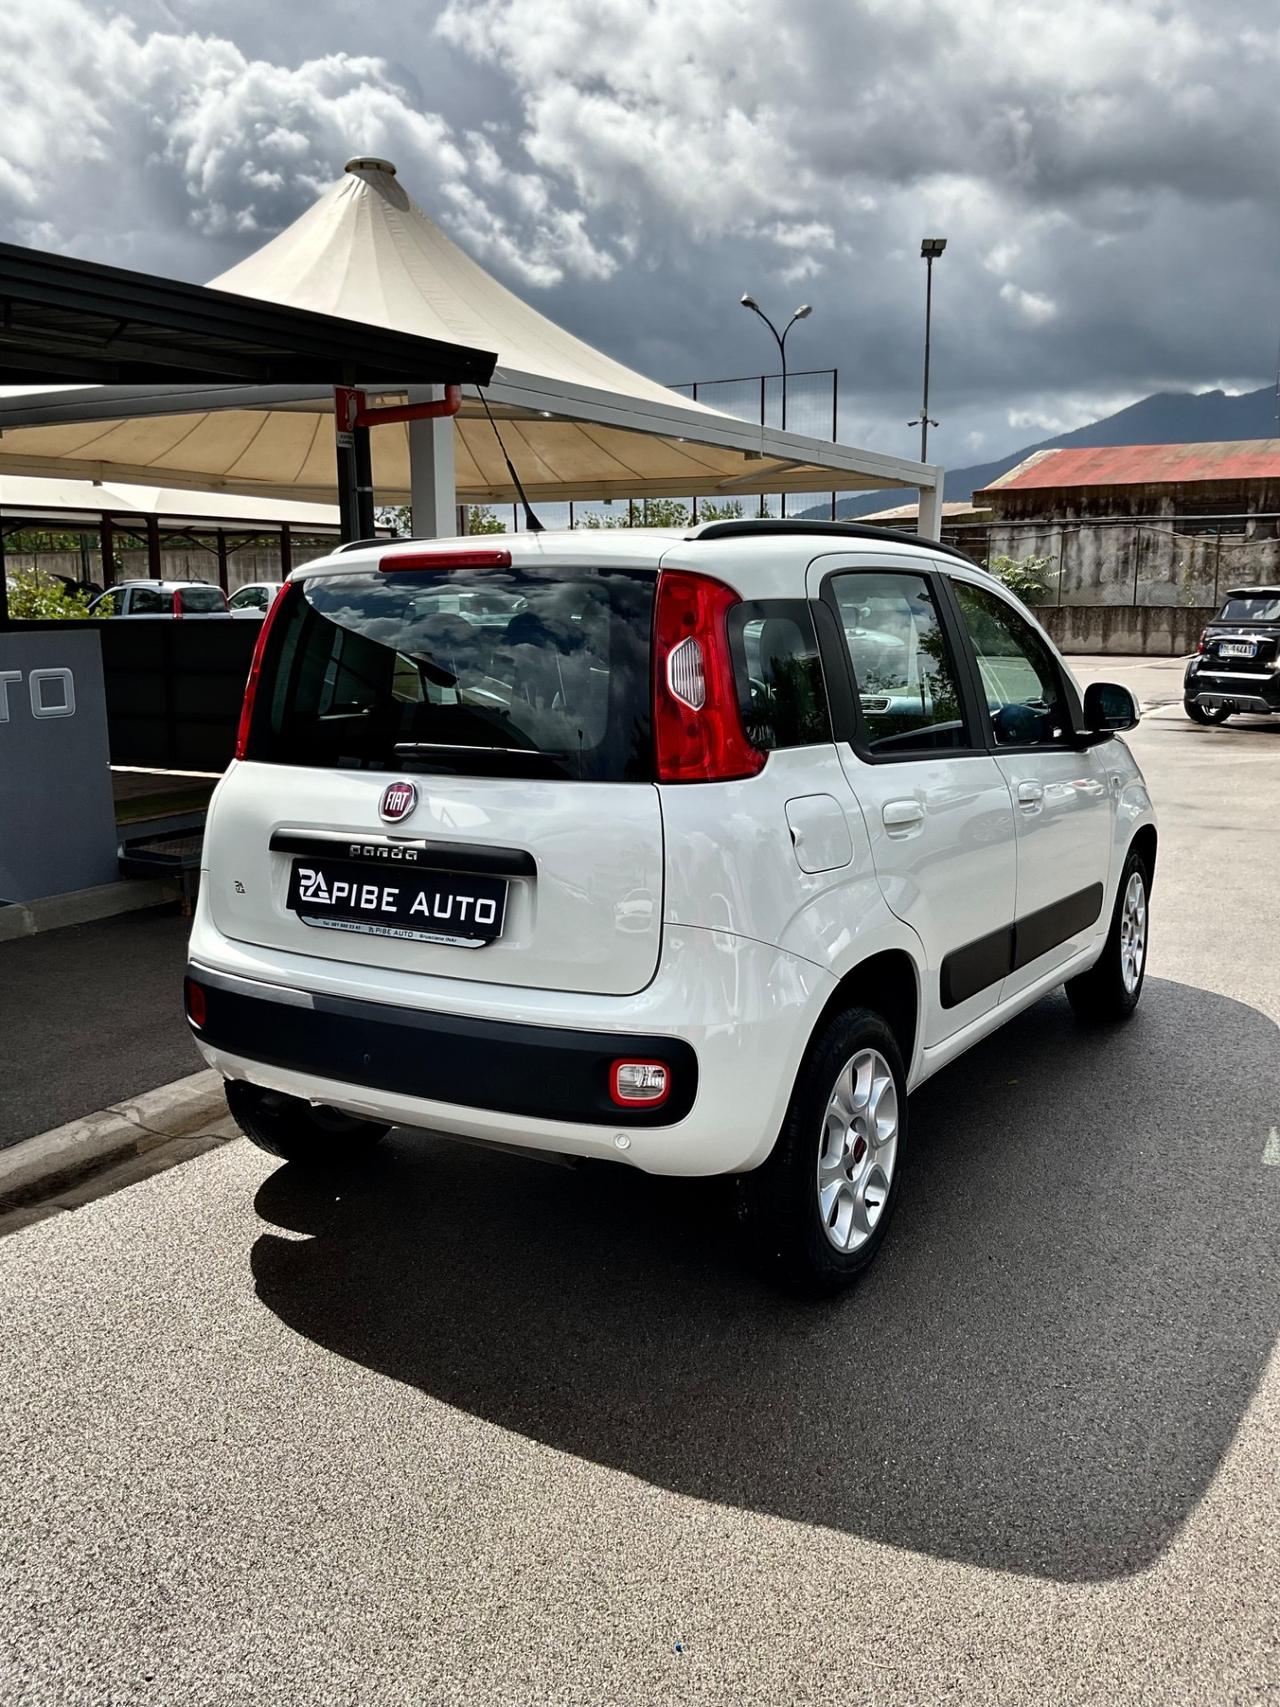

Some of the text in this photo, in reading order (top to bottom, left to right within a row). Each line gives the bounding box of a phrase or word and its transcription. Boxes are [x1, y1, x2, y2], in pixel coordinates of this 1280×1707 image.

[385, 791, 410, 811] FIAT
[350, 844, 418, 860] panda
[331, 881, 400, 912] PIBE
[409, 891, 496, 924] AUTO
[394, 929, 414, 938] AUTO
